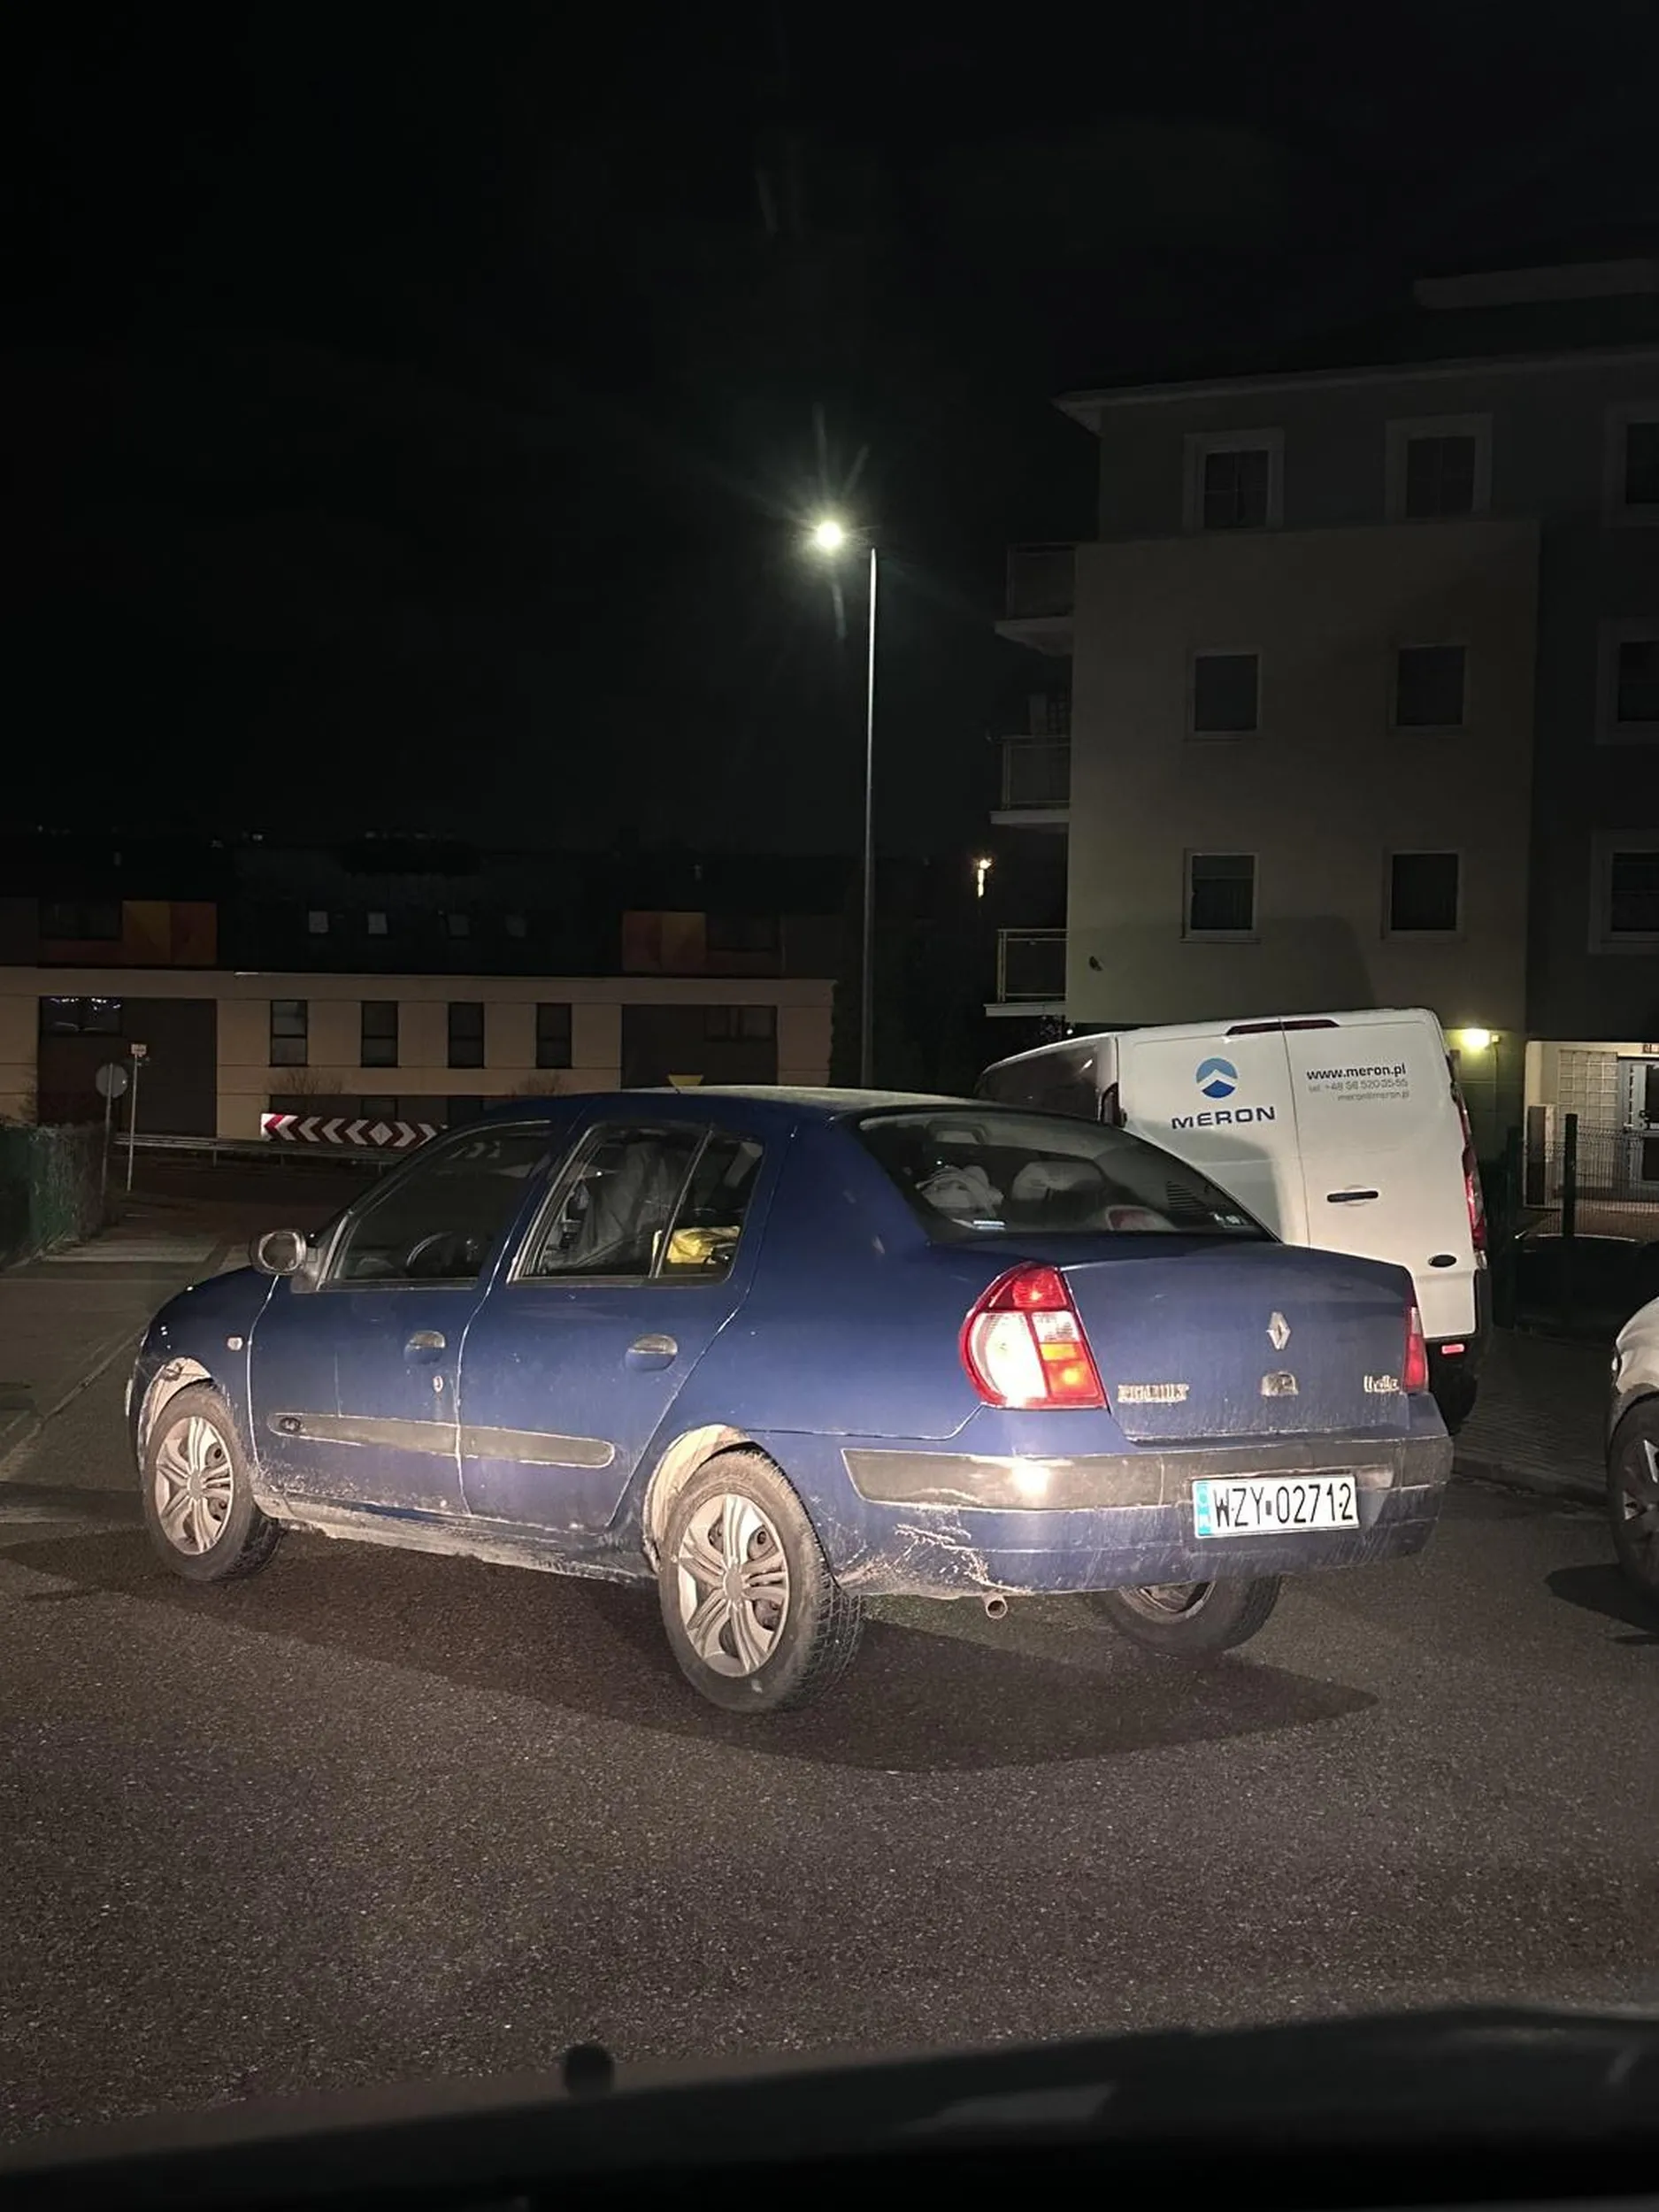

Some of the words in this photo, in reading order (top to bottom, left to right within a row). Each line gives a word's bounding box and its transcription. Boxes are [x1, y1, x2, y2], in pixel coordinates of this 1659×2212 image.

[1307, 1063, 1406, 1079] www.meron.pl
[1171, 1106, 1275, 1129] MERON
[1213, 1486, 1264, 1528] WZY
[1277, 1483, 1353, 1524] 02712
